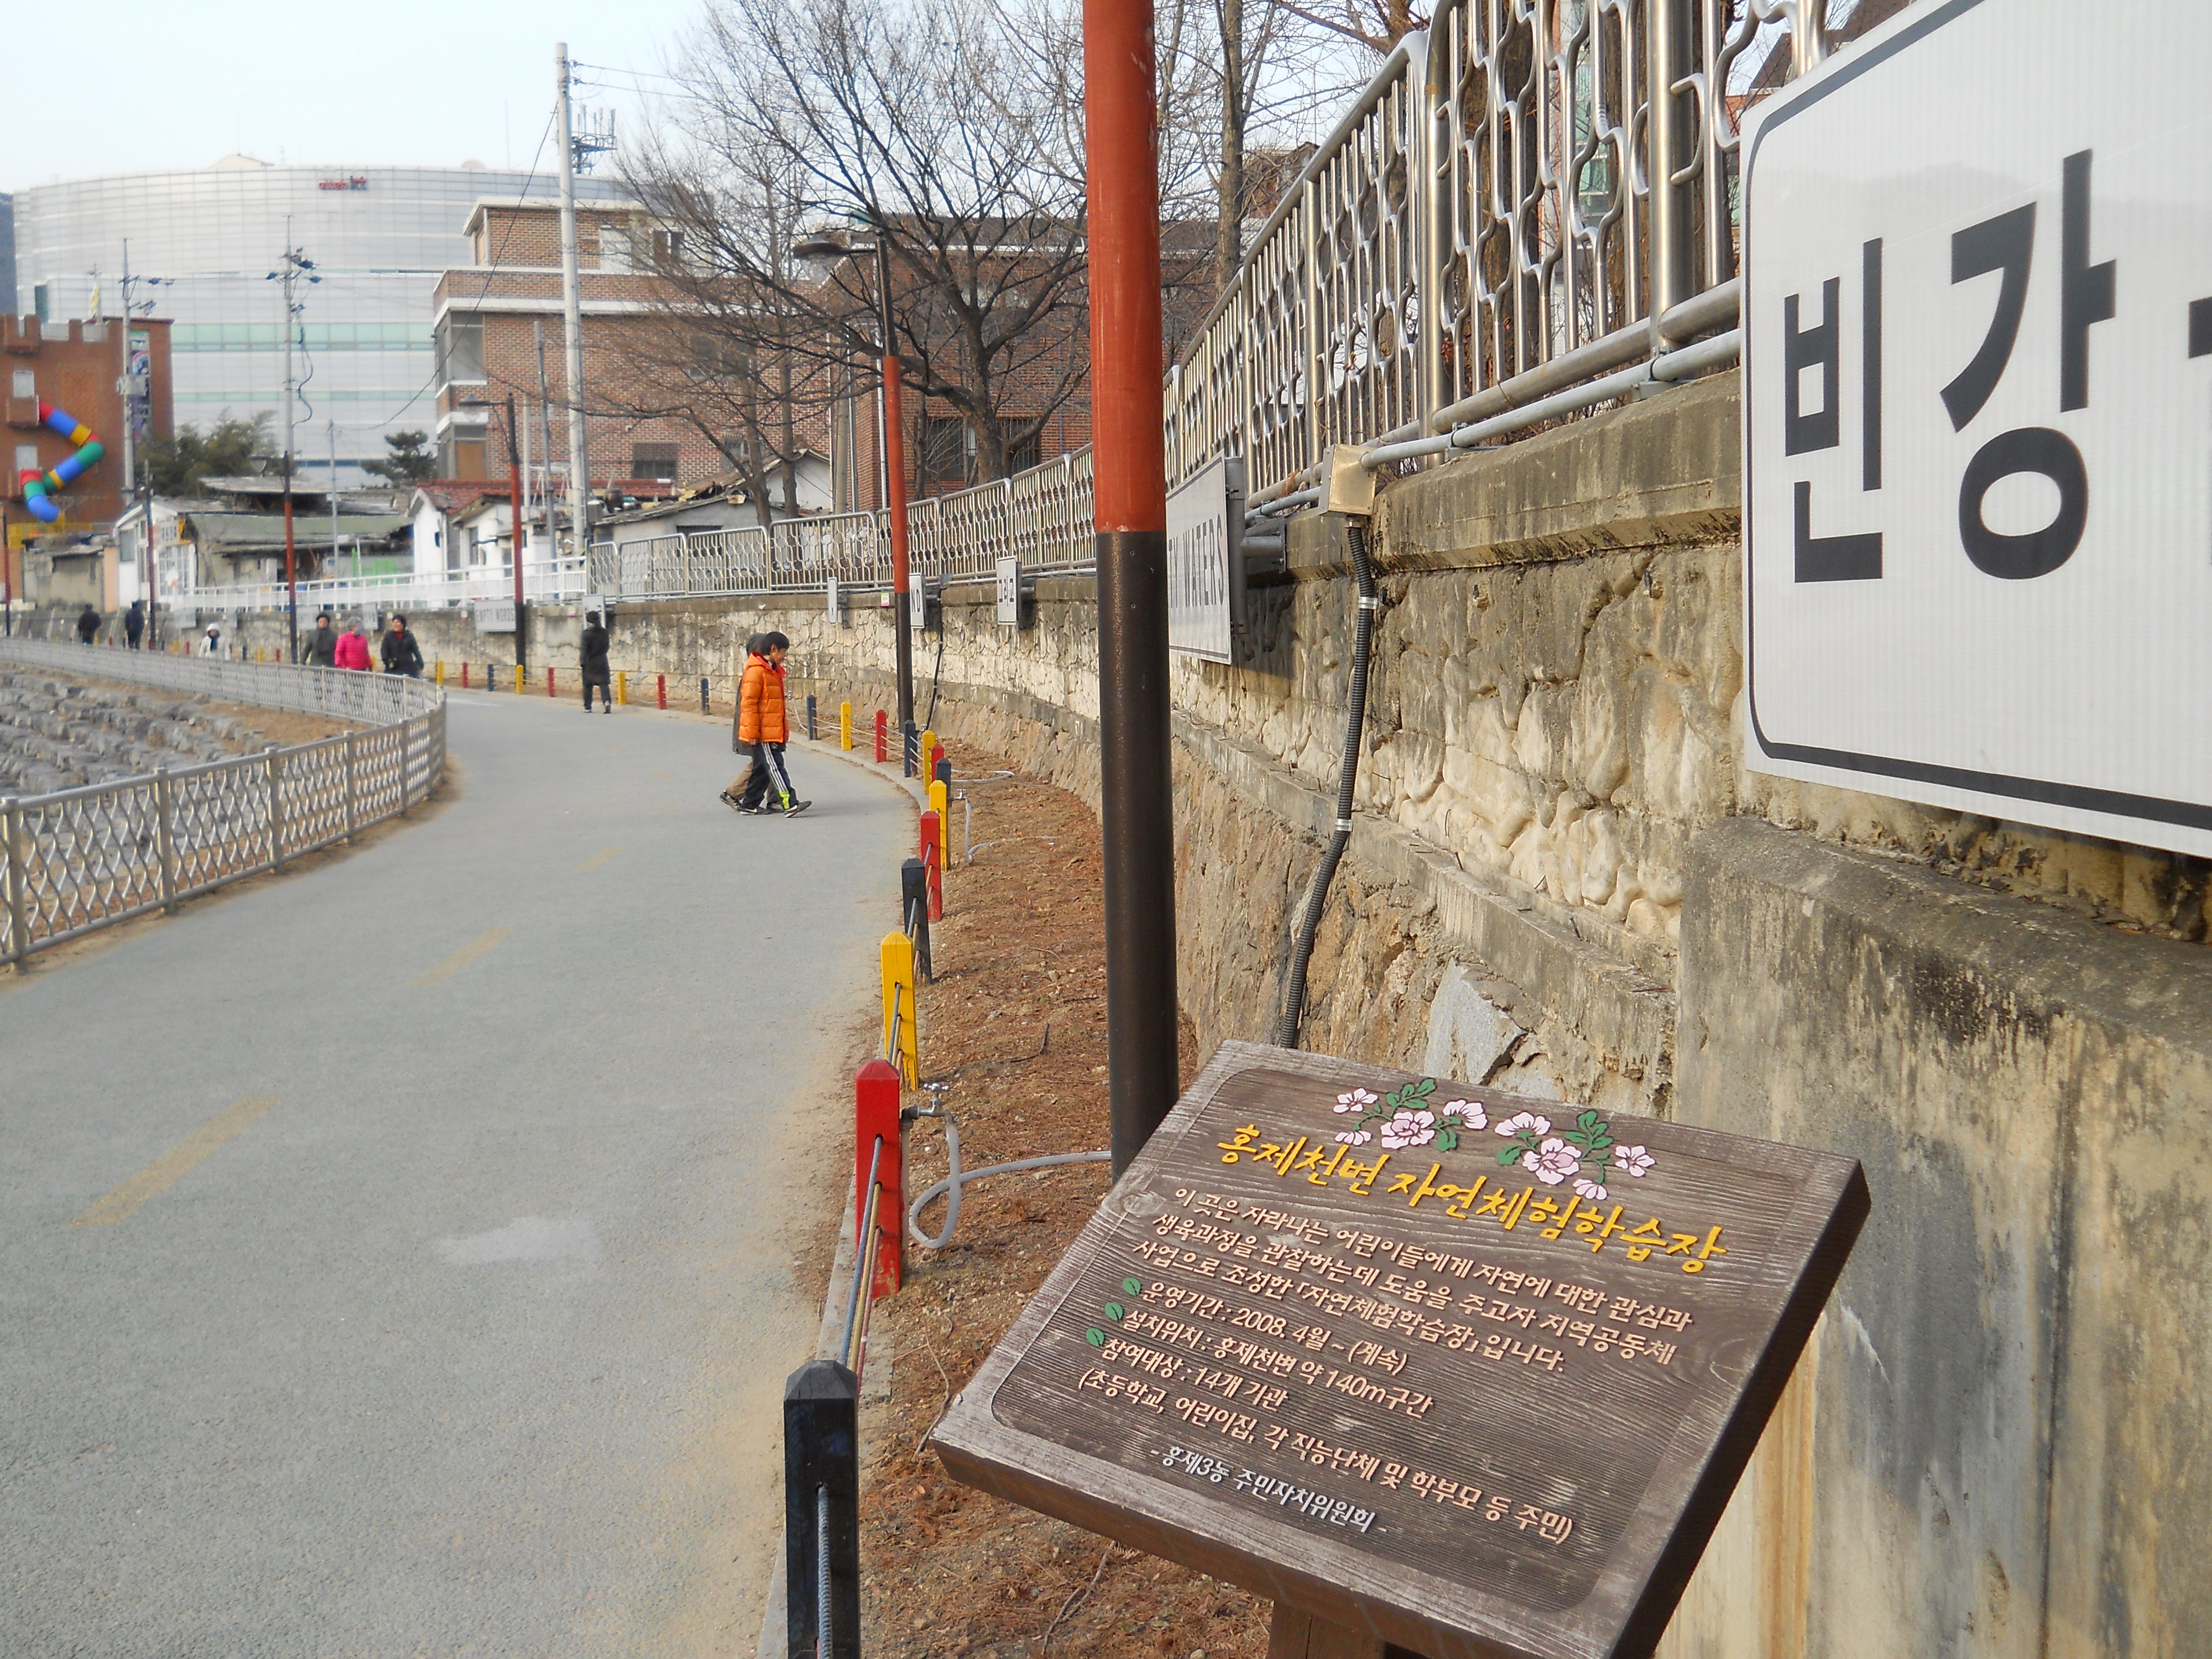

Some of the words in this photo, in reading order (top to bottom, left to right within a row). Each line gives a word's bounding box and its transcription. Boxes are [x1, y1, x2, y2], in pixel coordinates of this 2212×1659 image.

[1182, 513, 1224, 608] WATERS
[1218, 1124, 1389, 1196] 홍제천변
[1387, 1163, 1728, 1273] 자연체험학습장
[1133, 1240, 1221, 1278] 사업으로
[1221, 1265, 1295, 1300] 조성한
[1153, 1213, 1258, 1258] 생육과정을
[1261, 1241, 1381, 1287] 관찰하는데
[1379, 1274, 1453, 1310] 도움을
[1458, 1293, 1538, 1333] 주고자
[1540, 1314, 1678, 1365] 지역공동체
[1175, 1188, 1197, 1207] 이
[1193, 1193, 1239, 1221] 곳은
[1241, 1205, 1331, 1245] 자라나는
[1336, 1229, 1475, 1280] 어린이들에게
[1473, 1264, 1553, 1298] 자연에
[1554, 1283, 1608, 1314] 대한
[1609, 1296, 1693, 1332] 관심과
[1214, 1337, 1296, 1379] 홍제천변
[1299, 1361, 1325, 1386] 약
[1325, 1369, 1434, 1420] 140m구간
[1231, 1307, 1286, 1338] 2008.
[1292, 1324, 1333, 1352] 4월
[1348, 1340, 1408, 1375] (계속)
[1243, 1380, 1290, 1413] 기관
[1078, 1366, 1168, 1414] (초등학교,
[1175, 1395, 1259, 1443] 어린이집,
[1264, 1425, 1290, 1451] 각
[1291, 1432, 1381, 1482] 직능단체
[1380, 1462, 1410, 1490] 및
[1411, 1471, 1483, 1511] 학부모
[1485, 1495, 1513, 1522] 등
[1514, 1504, 1574, 1546] 주민)
[1233, 1468, 1376, 1533] 주민자치위원회
